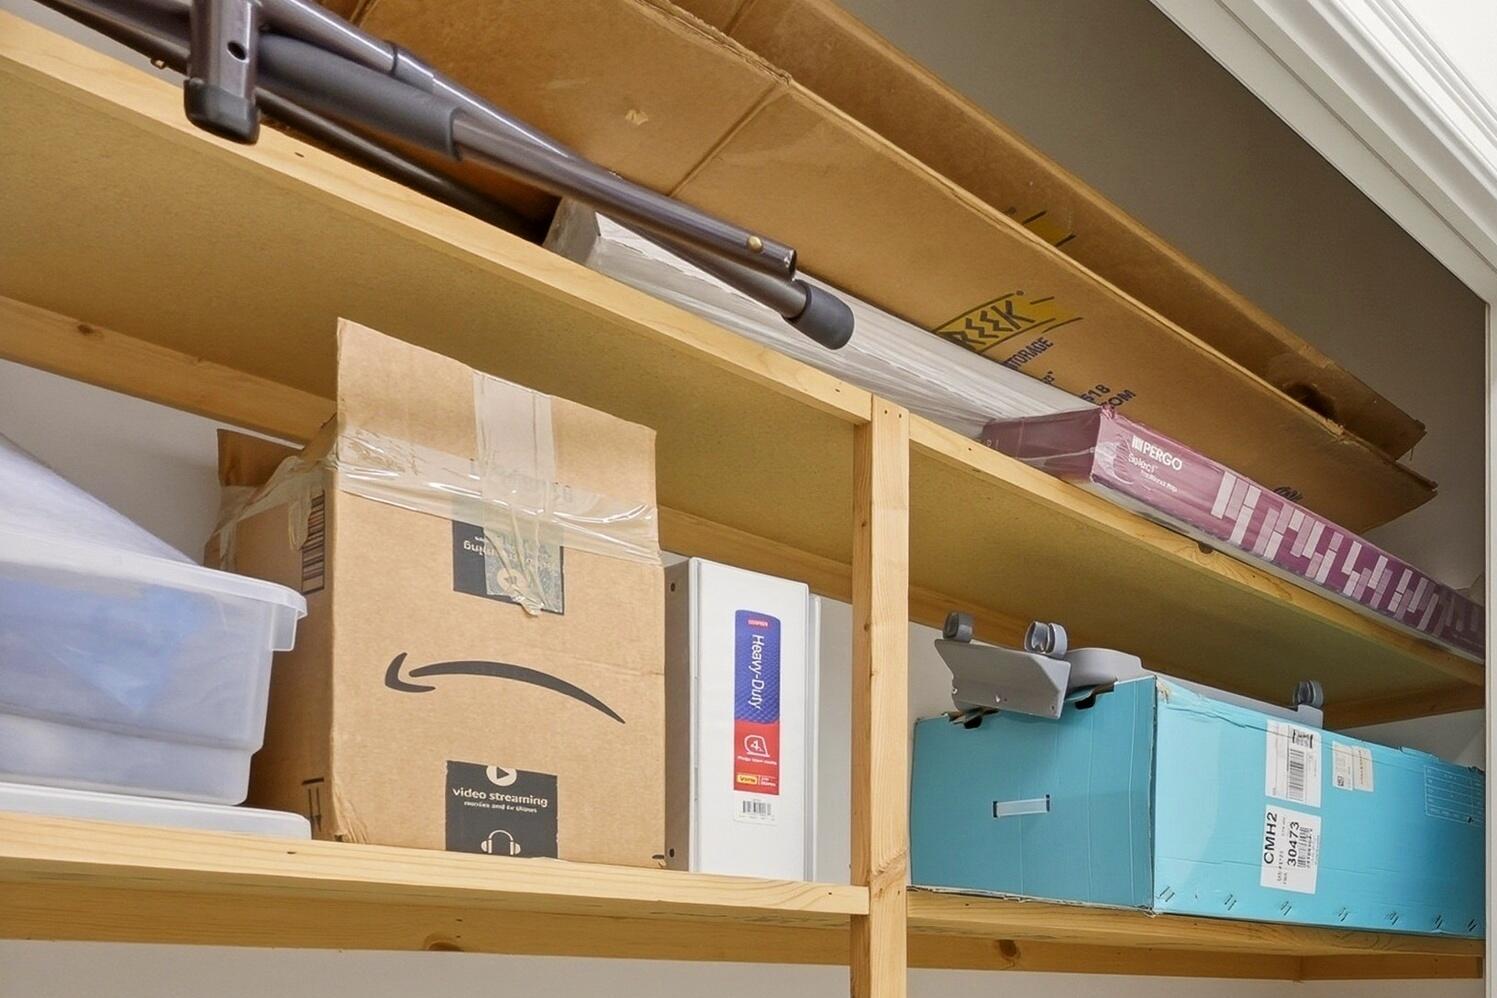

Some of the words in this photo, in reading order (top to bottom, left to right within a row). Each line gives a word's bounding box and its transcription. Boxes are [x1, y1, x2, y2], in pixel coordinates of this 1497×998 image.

[1003, 337, 1054, 369] TORAGE
[1128, 453, 1155, 473] Select
[1142, 443, 1183, 471] PERGO
[748, 634, 765, 710] Heavy-Duty
[452, 786, 487, 800] video
[489, 791, 548, 808] streaming
[1263, 811, 1278, 864] CMH2
[1286, 821, 1300, 867] 30473
